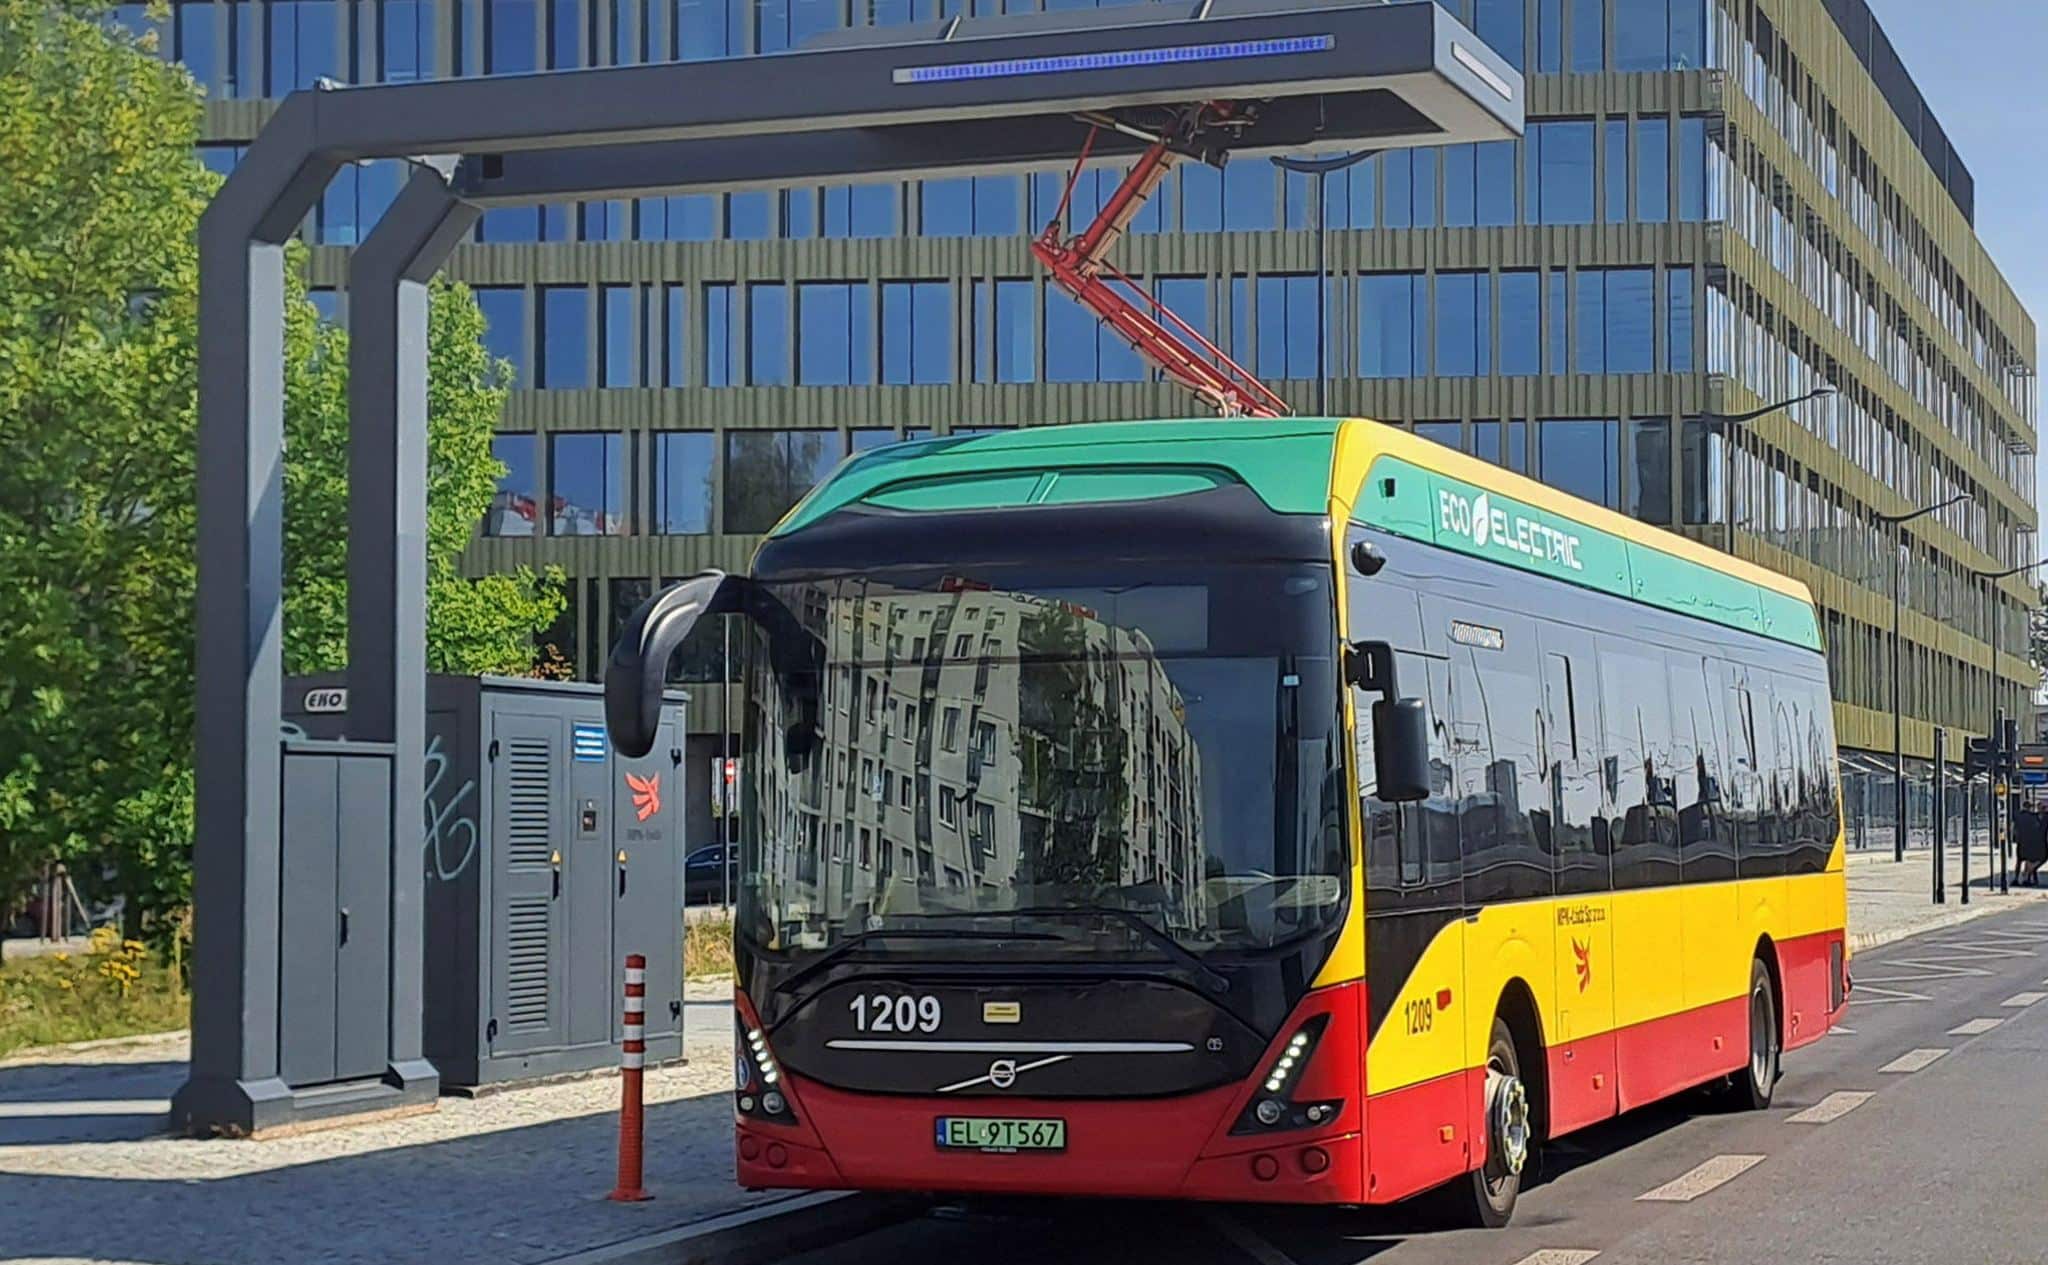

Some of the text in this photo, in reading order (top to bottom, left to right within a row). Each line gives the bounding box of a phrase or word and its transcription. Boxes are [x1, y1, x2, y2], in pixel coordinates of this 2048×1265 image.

[1438, 489, 1583, 571] ECO ELECTRIC
[850, 994, 941, 1033] 1209
[1404, 997, 1432, 1036] 1209
[950, 1121, 979, 1145] EL
[988, 1122, 1059, 1146] 9T567
